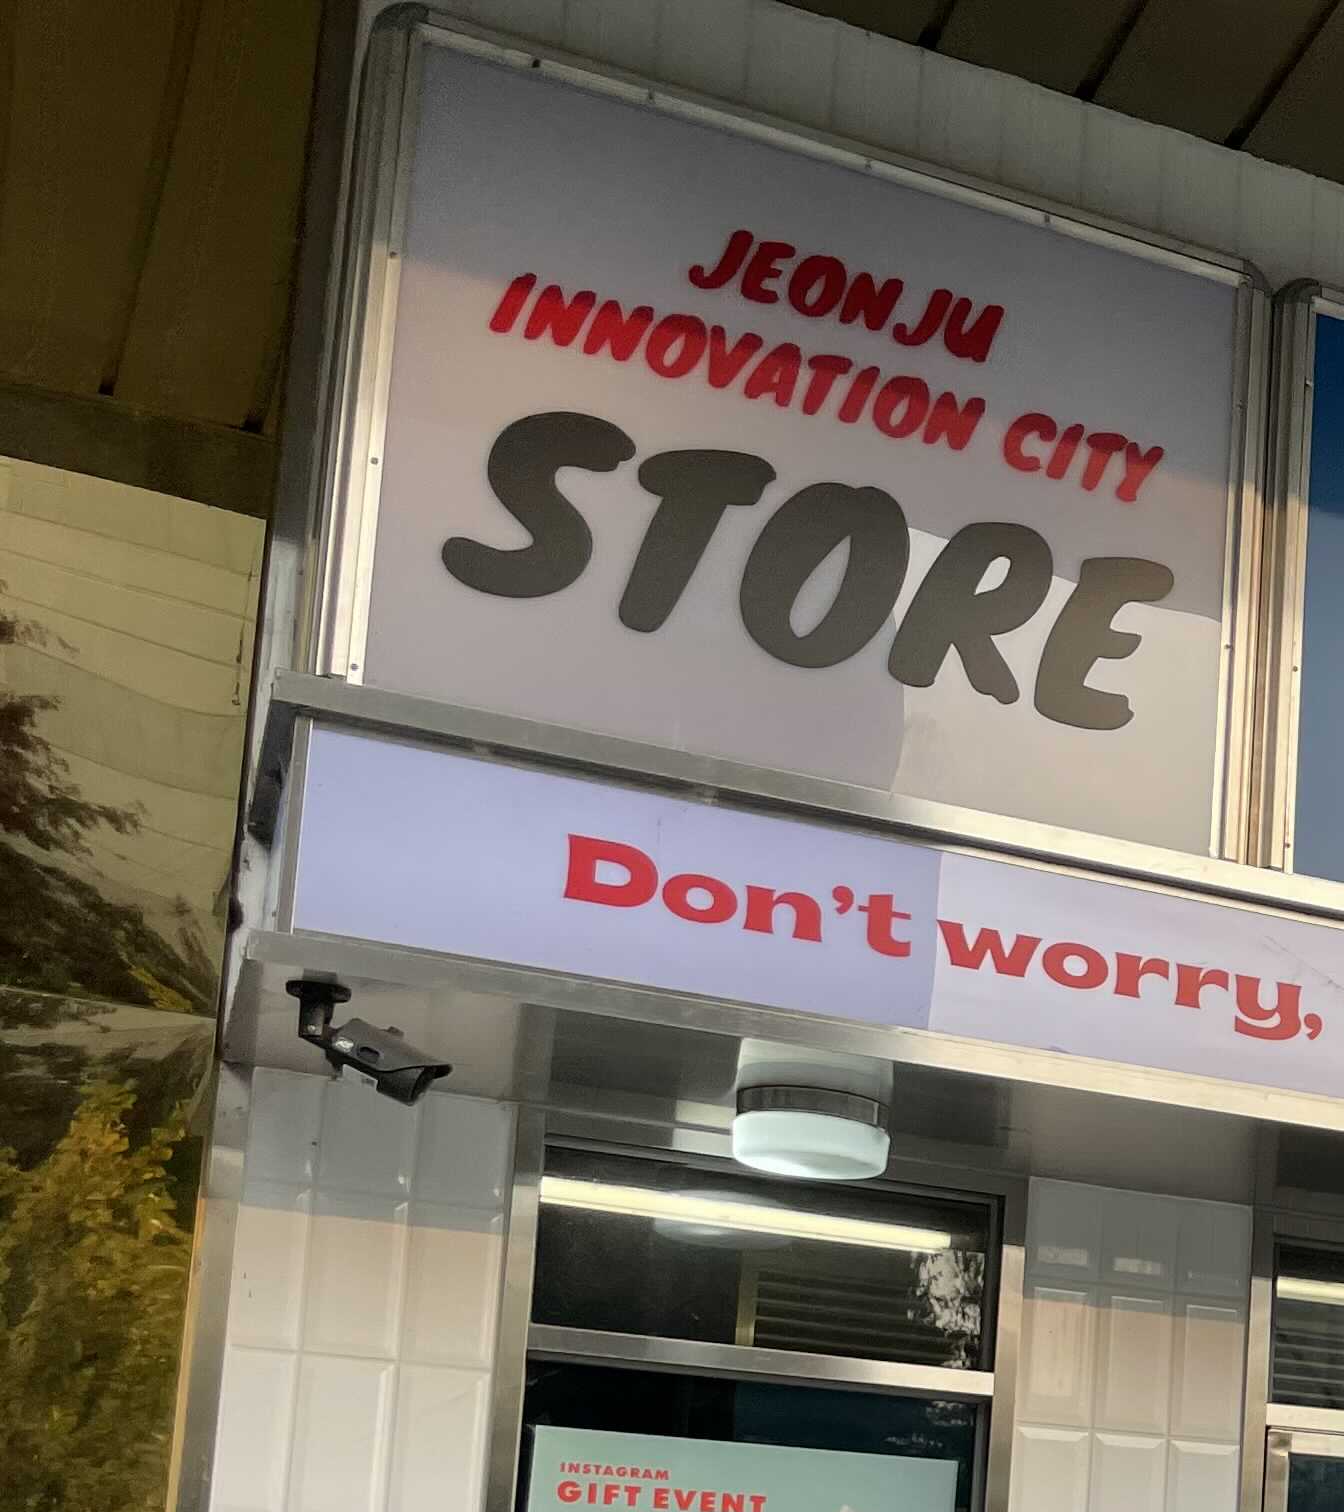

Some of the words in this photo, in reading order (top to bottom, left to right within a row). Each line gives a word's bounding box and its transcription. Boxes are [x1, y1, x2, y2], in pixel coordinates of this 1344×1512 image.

[689, 229, 1004, 363] JEONJU
[488, 273, 985, 451] INNOVATION
[1004, 413, 1165, 503] CITY
[441, 411, 1175, 731] STORE
[936, 918, 1323, 1042] worry,
[557, 1480, 641, 1507] GIFT
[559, 1462, 670, 1481] INSTAGRAM
